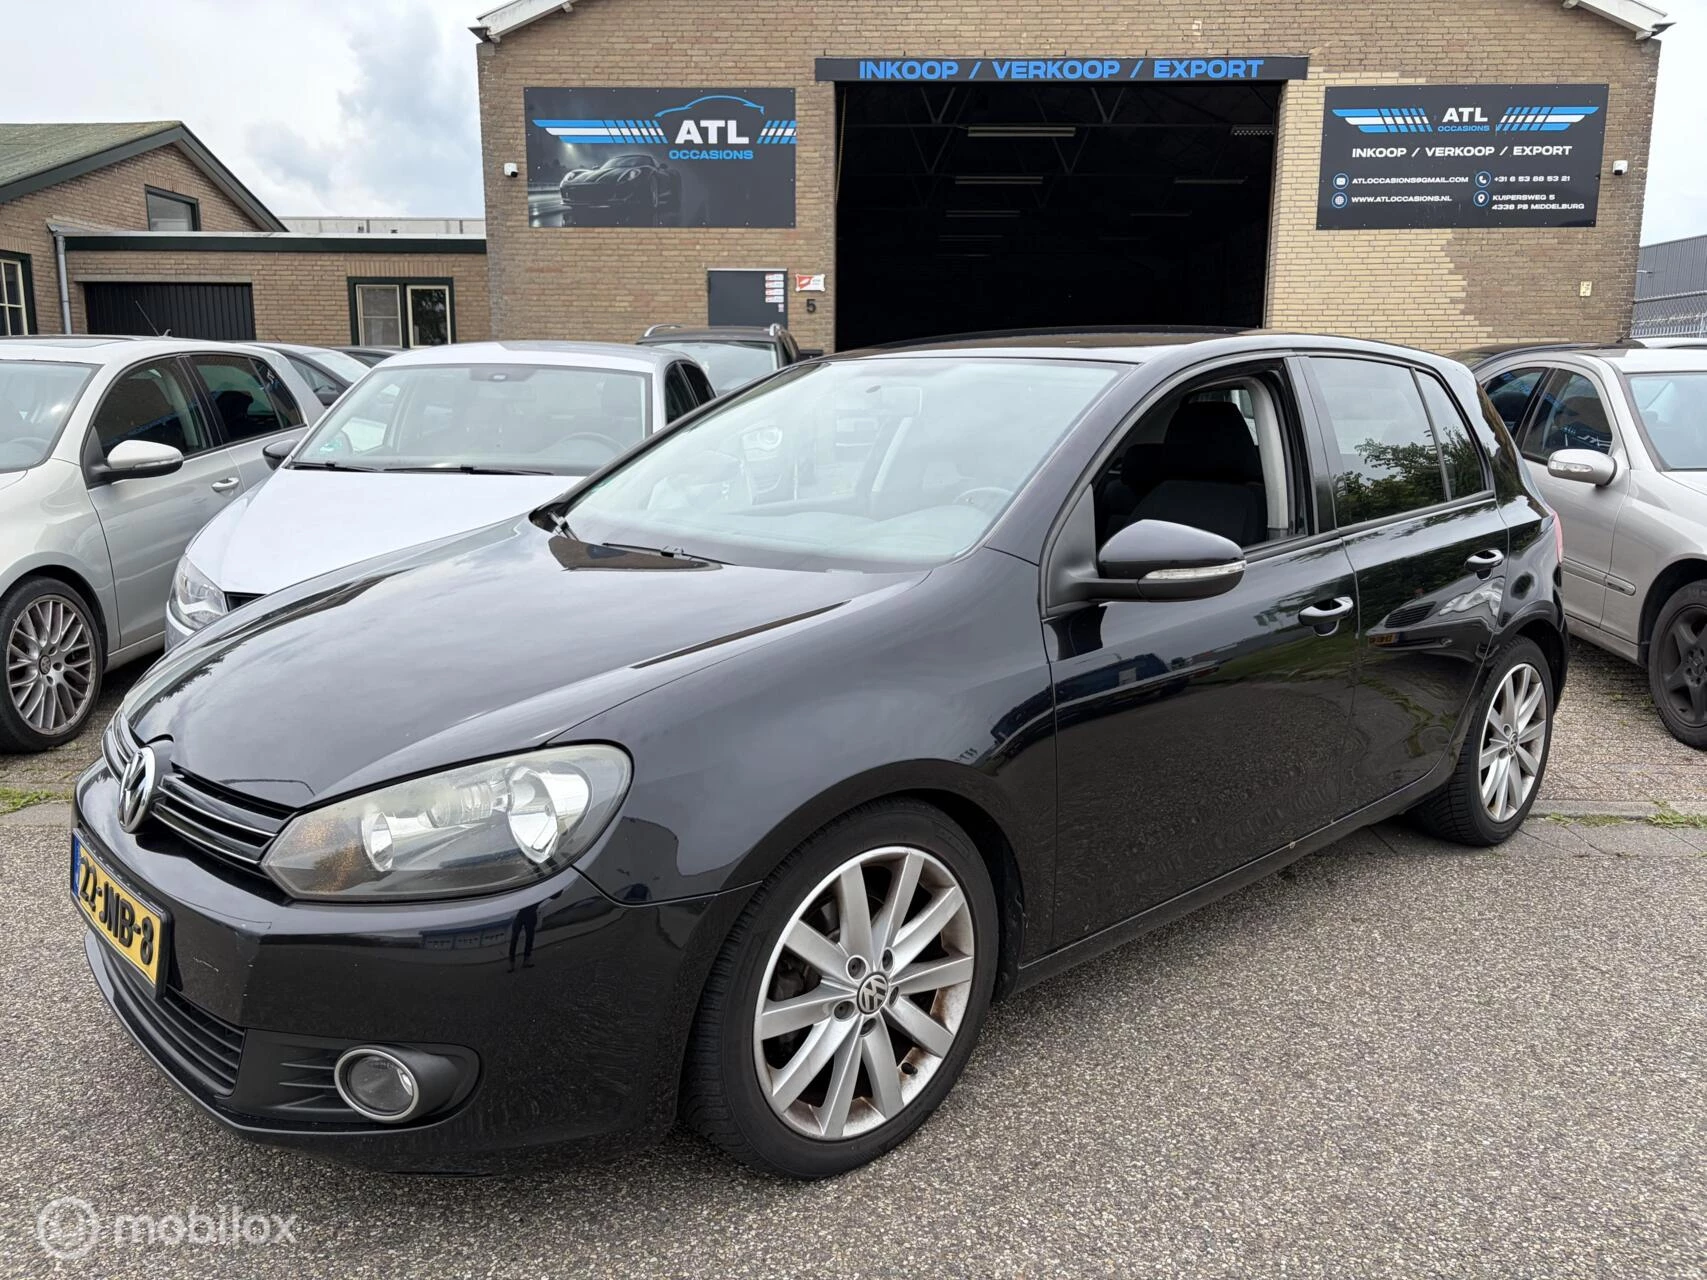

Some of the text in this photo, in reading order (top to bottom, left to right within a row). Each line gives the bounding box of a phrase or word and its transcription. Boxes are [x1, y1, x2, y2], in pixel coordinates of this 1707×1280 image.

[859, 59, 1264, 80] INKOOP / VERKOOP / EXPORT
[1442, 107, 1489, 123] ATL
[675, 120, 749, 144] ATL
[668, 150, 754, 160] OCCASIONS
[1351, 145, 1573, 158] INKOOP / VERKOOP / EXPORT
[1351, 195, 1453, 203] WWW.ATLOCCASIONS.NL
[806, 299, 816, 313] 5
